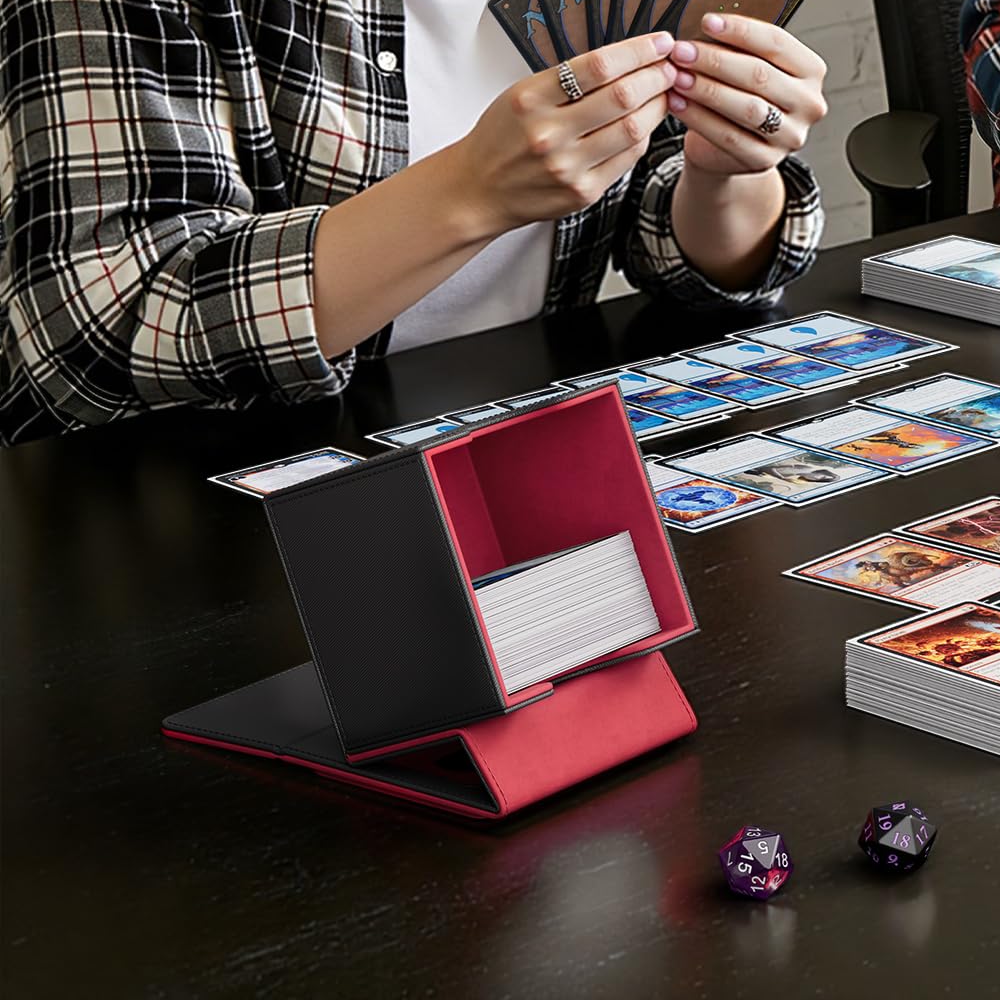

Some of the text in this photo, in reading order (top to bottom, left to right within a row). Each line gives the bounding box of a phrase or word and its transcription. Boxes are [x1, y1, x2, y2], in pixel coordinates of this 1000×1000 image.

[893, 832, 911, 848] 18
[916, 825, 929, 846] 17
[757, 841, 769, 854] 5
[738, 852, 754, 874] 15
[775, 852, 789, 868] 18
[750, 876, 766, 893] 12
